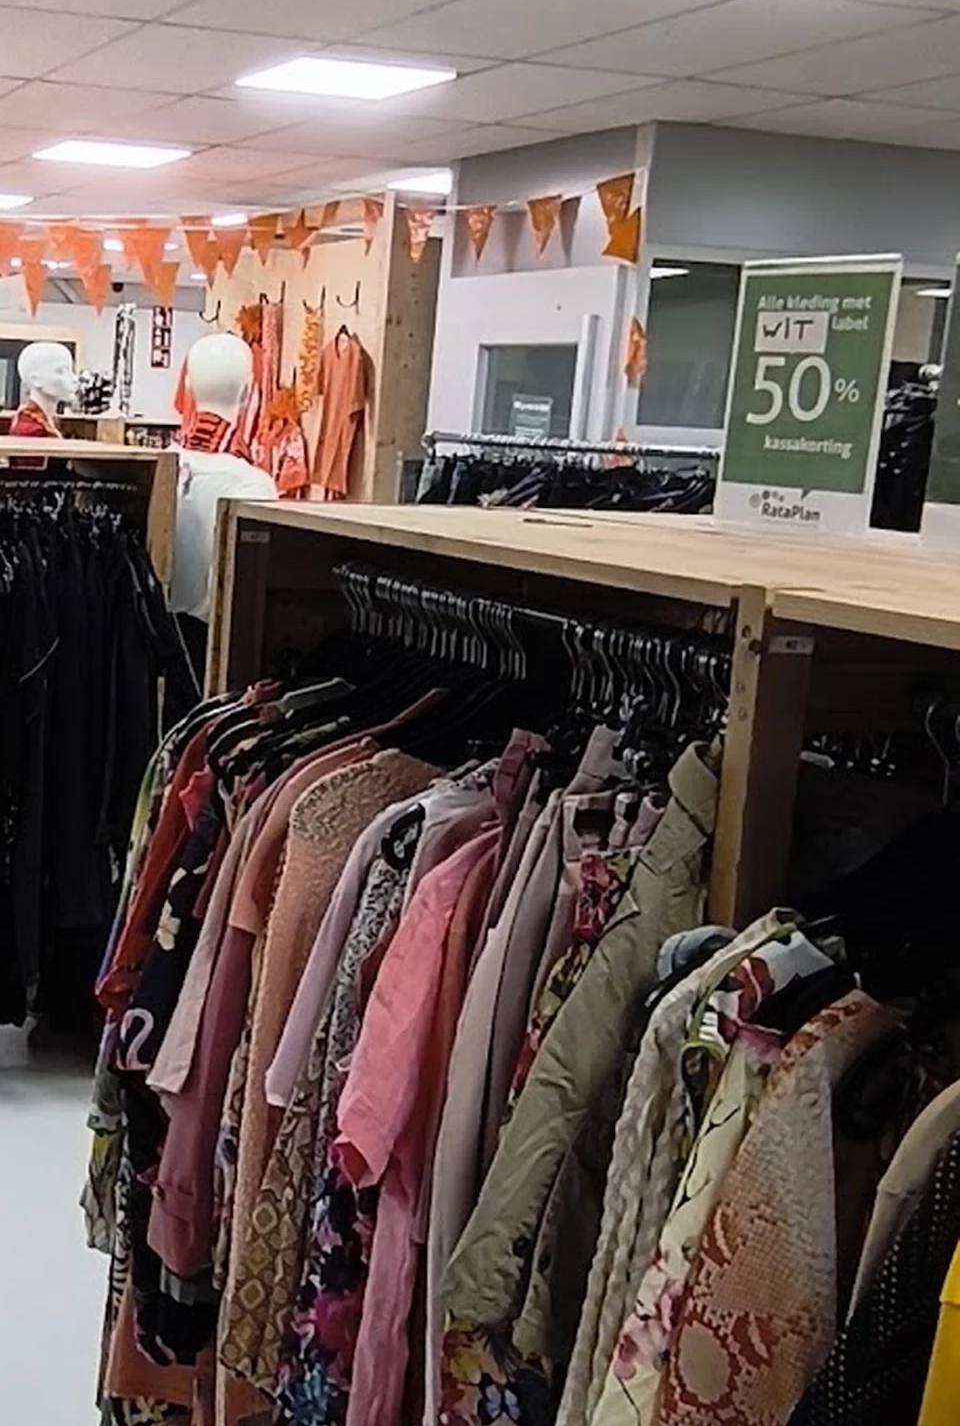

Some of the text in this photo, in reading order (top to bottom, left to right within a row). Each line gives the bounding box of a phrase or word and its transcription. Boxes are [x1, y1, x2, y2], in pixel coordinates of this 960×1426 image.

[758, 295, 872, 314] Alle kleding met
[831, 315, 869, 331] label
[763, 435, 853, 459] kassakorting
[761, 502, 821, 521] RataPlan
